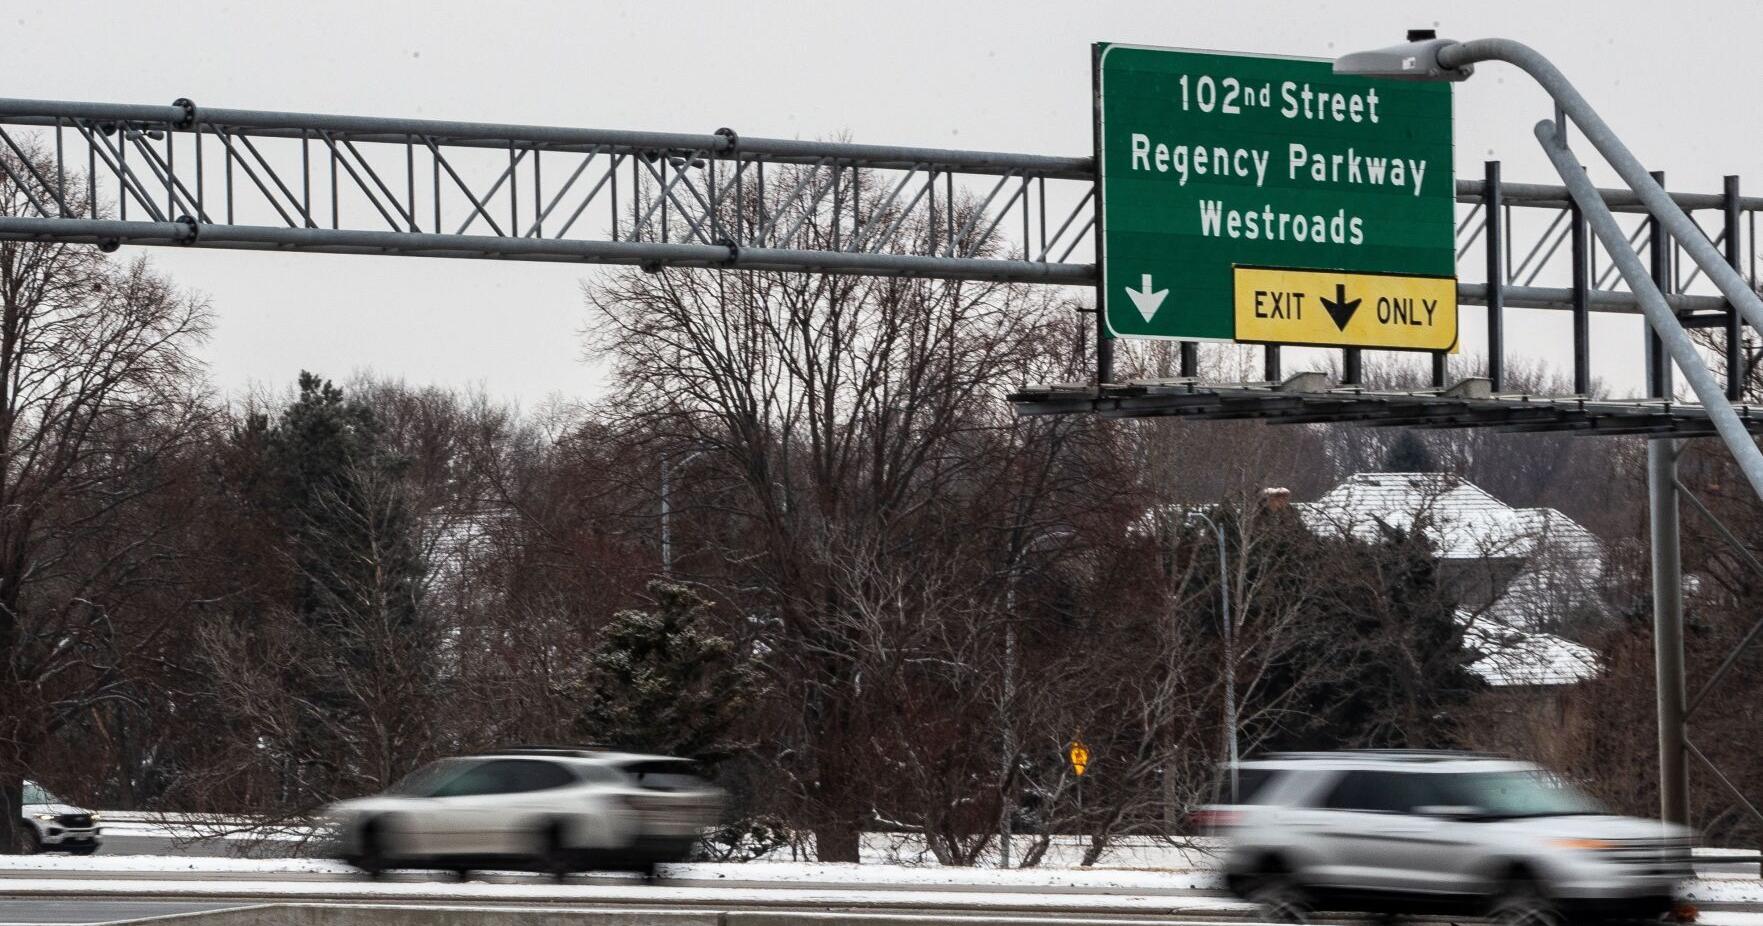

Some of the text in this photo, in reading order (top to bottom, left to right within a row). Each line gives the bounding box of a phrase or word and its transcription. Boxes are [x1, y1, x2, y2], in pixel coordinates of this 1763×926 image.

[1179, 74, 1380, 124] 102nd Street
[1131, 133, 1427, 197] Regency Parkway
[1199, 199, 1364, 245] Westroads
[1254, 290, 1438, 327] EXIT ONLY
